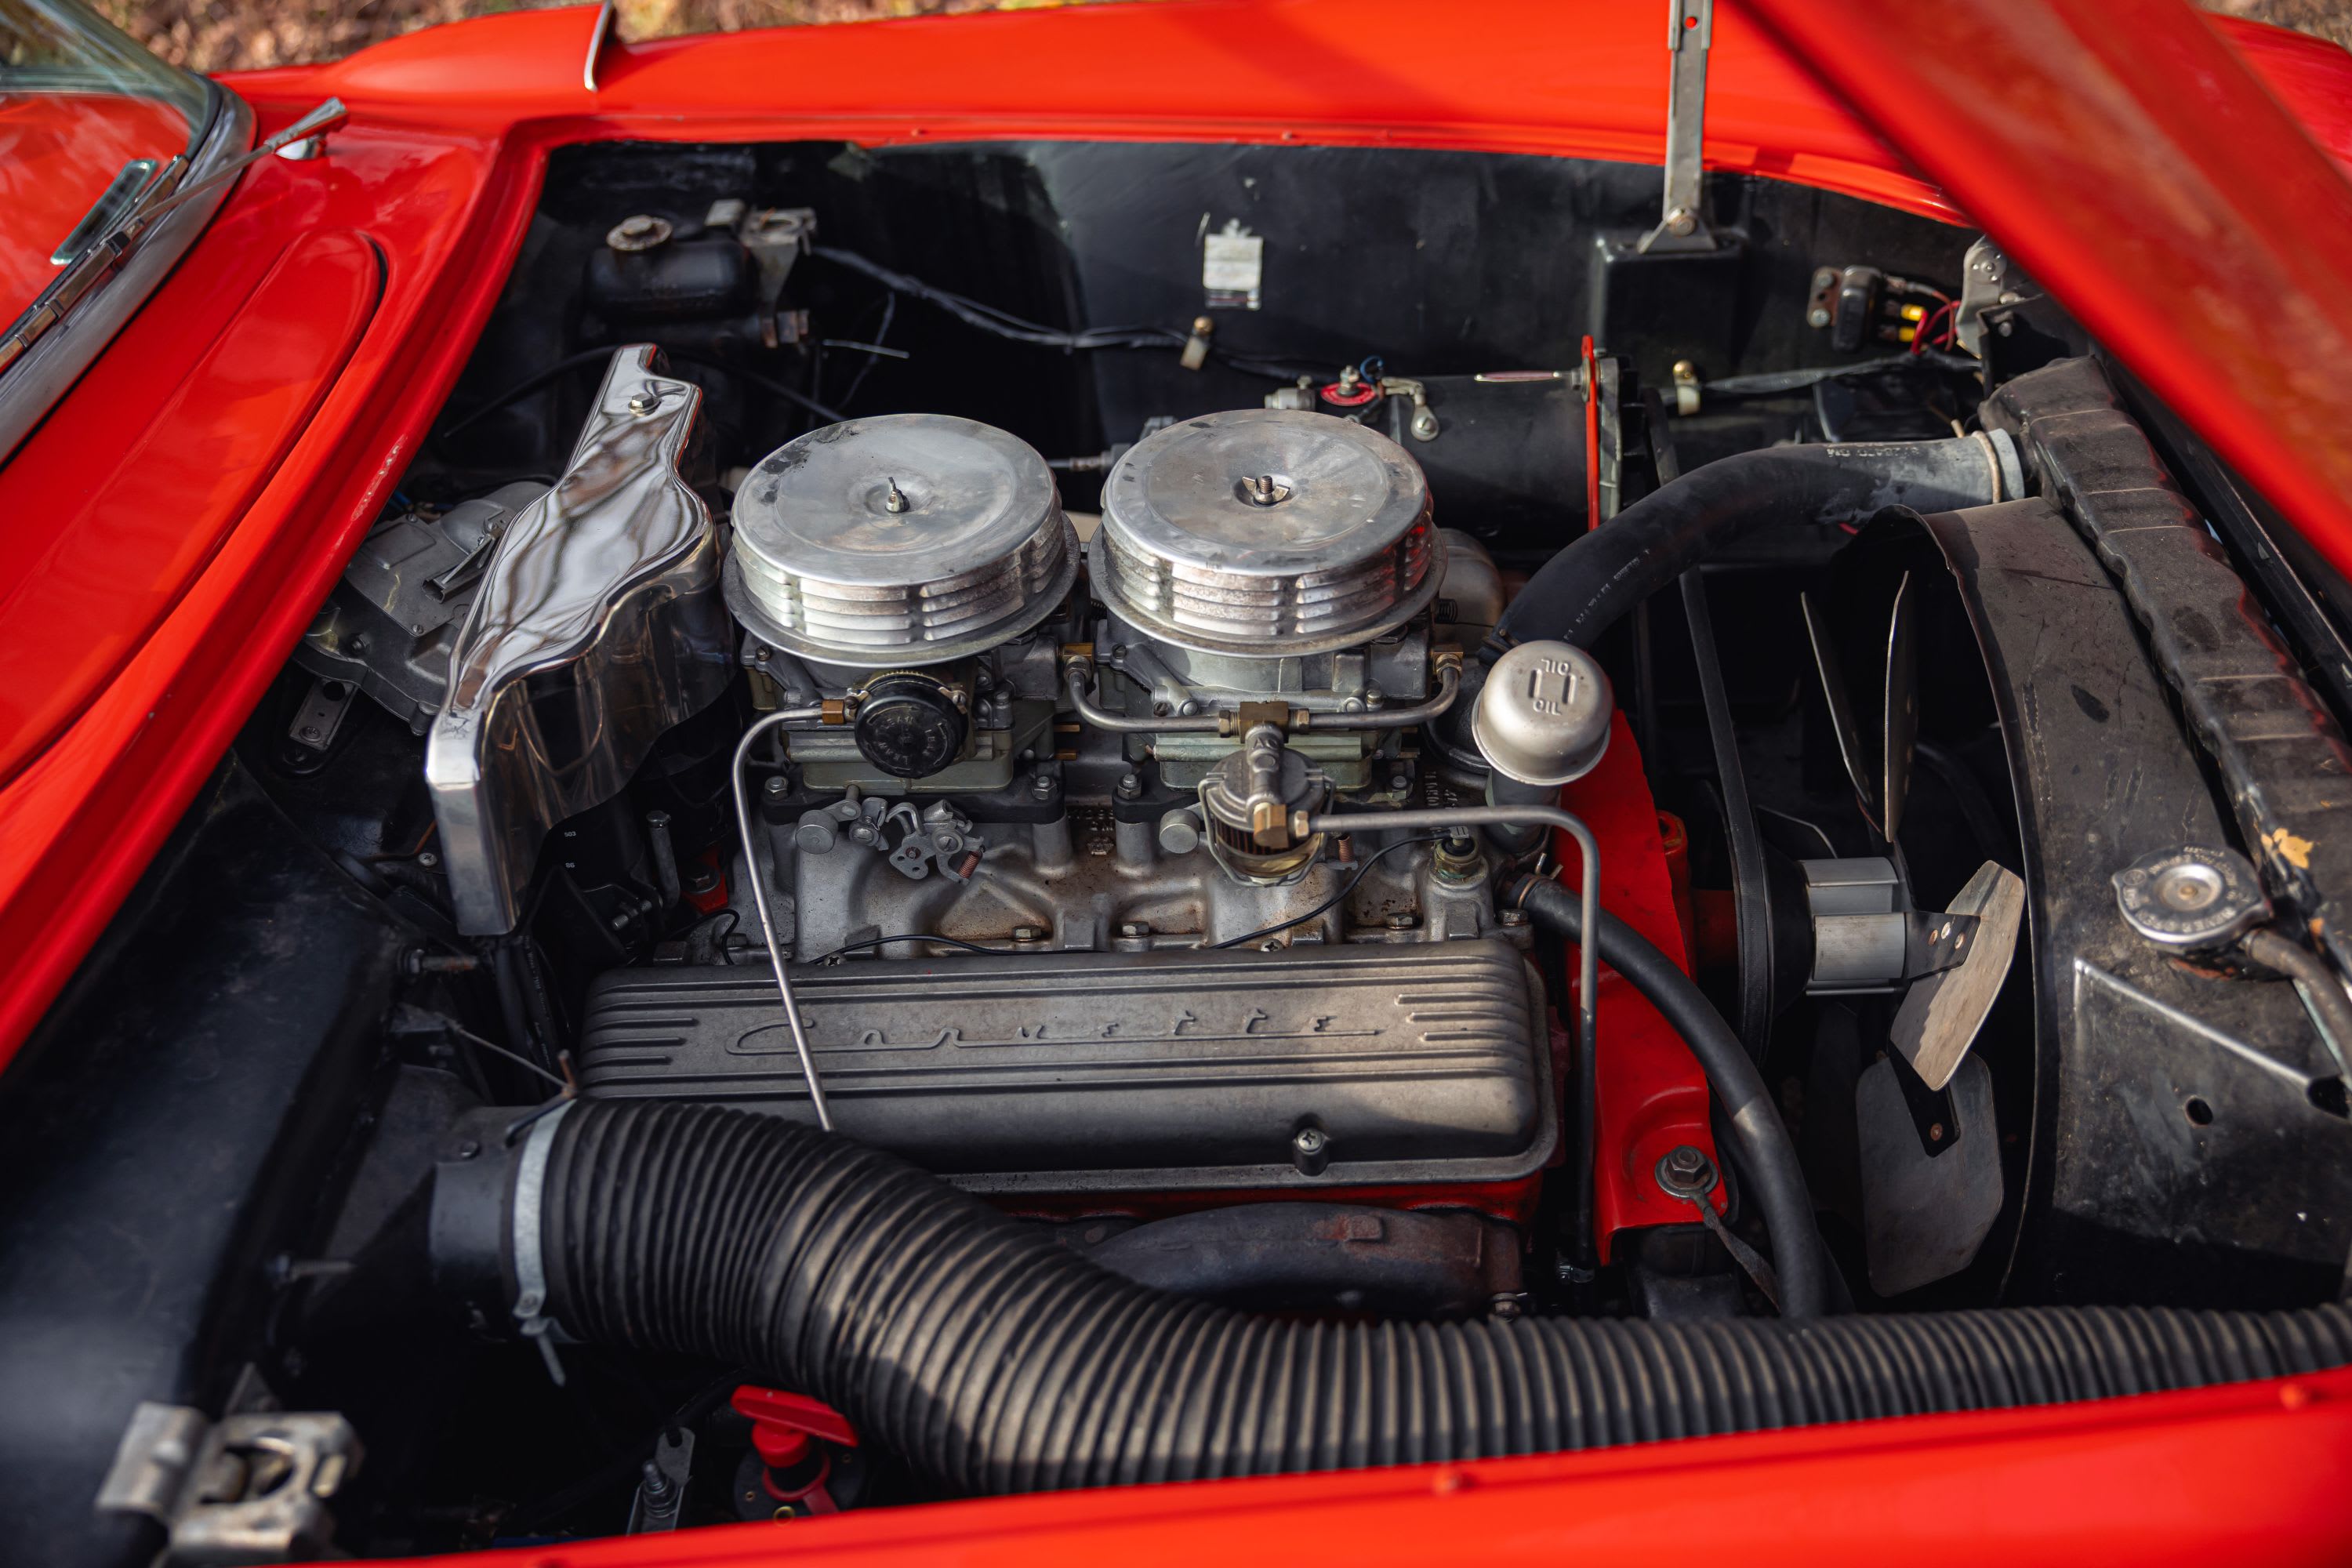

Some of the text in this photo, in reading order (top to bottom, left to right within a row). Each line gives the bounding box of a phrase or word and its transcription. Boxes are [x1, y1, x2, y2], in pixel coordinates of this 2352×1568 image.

[1541, 658, 1571, 676] OIL
[1533, 699, 1562, 717] OIL
[1253, 736, 1279, 751] AC
[725, 1008, 1386, 1055] Corvette
